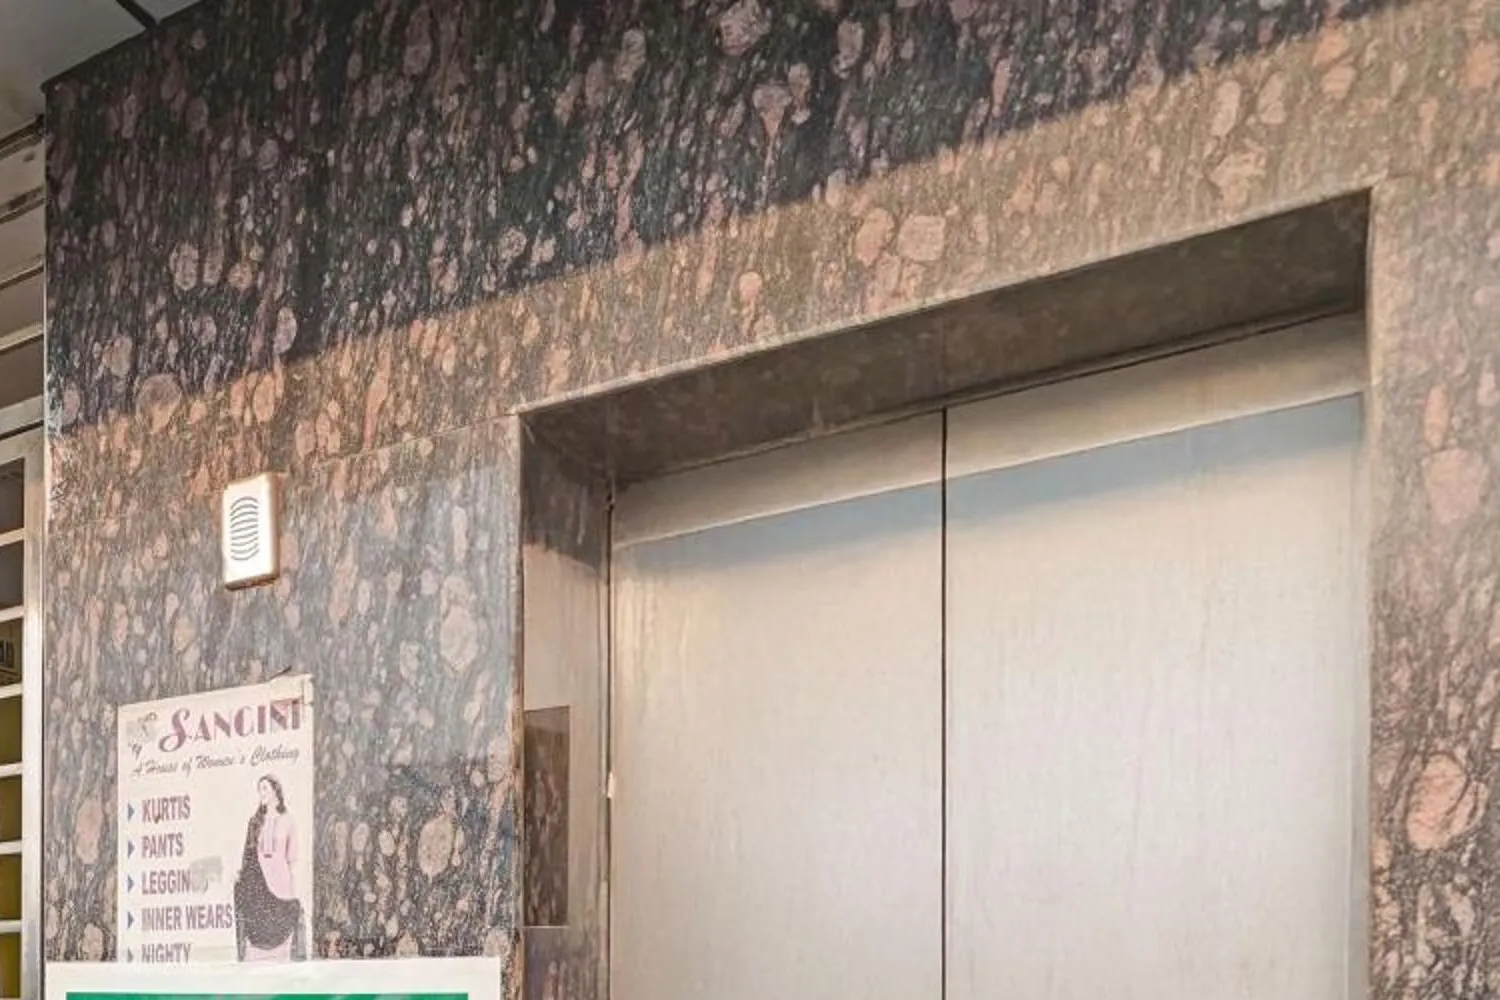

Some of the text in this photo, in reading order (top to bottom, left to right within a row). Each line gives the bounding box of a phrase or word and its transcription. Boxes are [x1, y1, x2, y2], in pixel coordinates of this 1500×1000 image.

[141, 795, 191, 823] KURTIS
[141, 832, 184, 859] PANTS
[141, 903, 233, 932] INNER WEARS
[141, 942, 192, 964] NIGHTY
